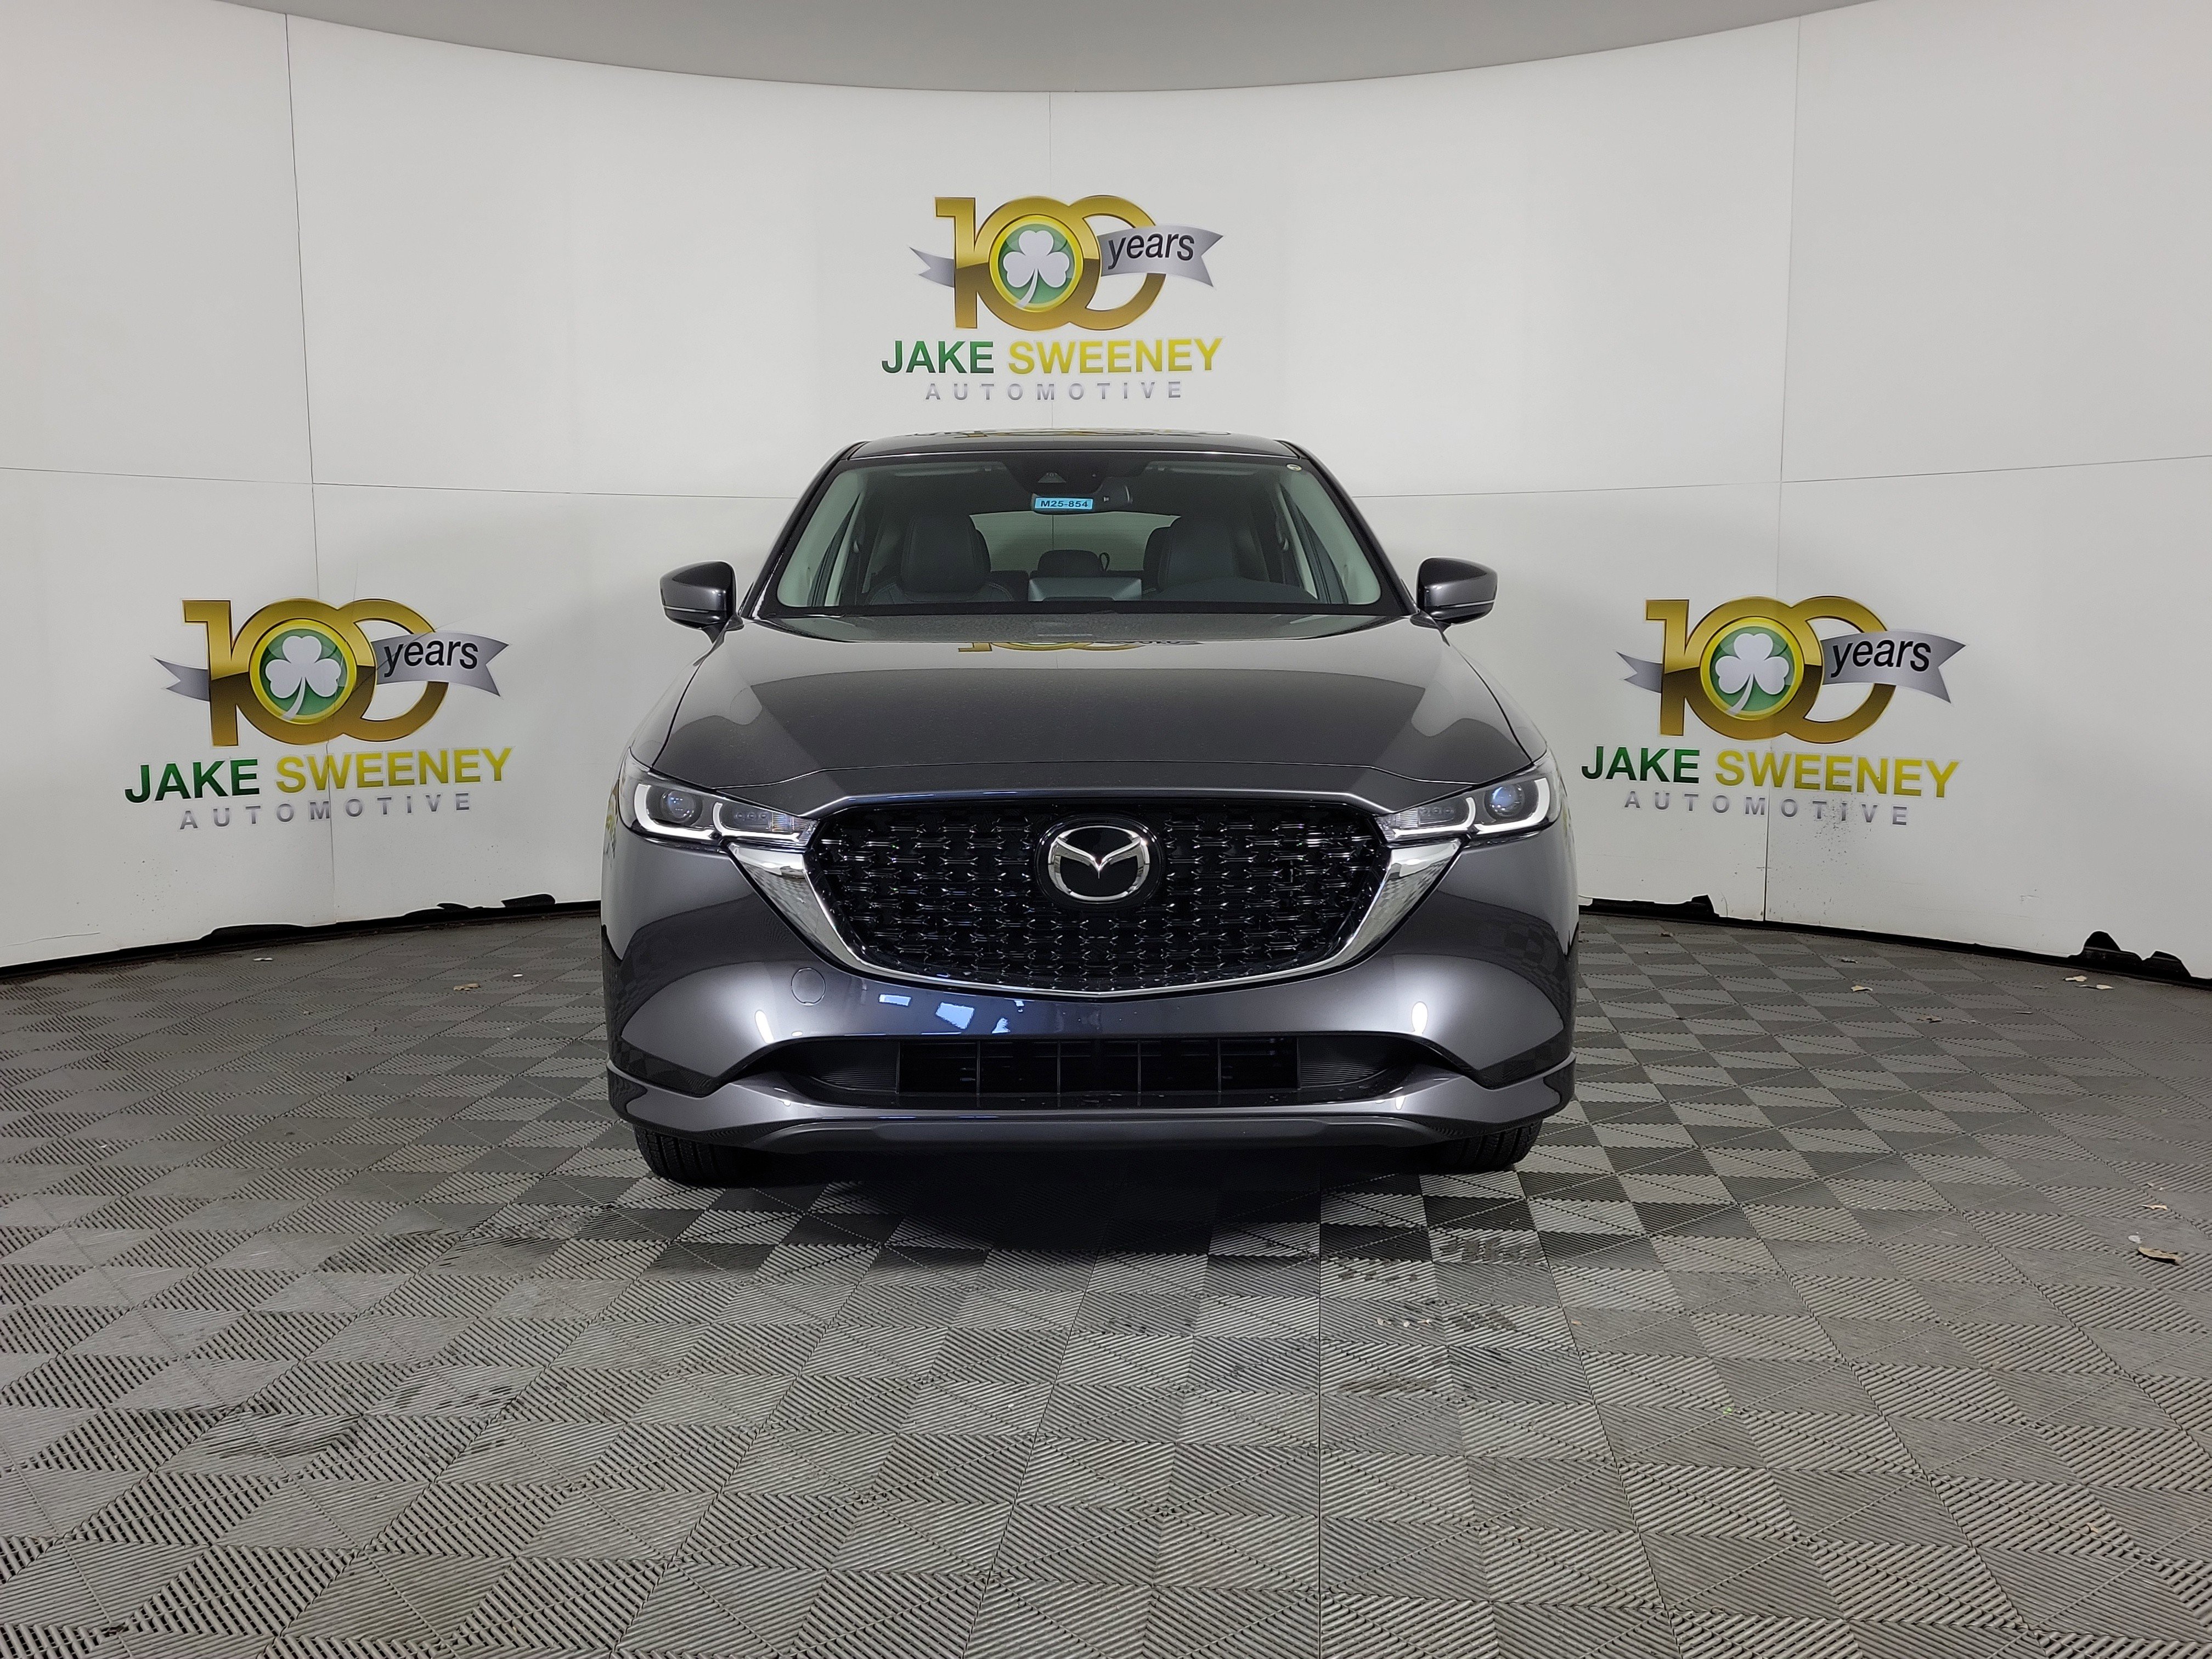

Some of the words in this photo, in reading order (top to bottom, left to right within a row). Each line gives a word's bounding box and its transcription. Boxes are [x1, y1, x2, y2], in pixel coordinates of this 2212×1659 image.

[934, 194, 1166, 331] 100
[1107, 233, 1195, 270] years
[881, 340, 994, 374] JAKE
[1008, 337, 1223, 374] SWEENEY
[925, 381, 1181, 400] AUTOMOTIVE
[182, 597, 449, 746] 100
[383, 640, 479, 677] years
[1646, 596, 1897, 744] 100
[1830, 639, 1932, 678] years
[125, 759, 260, 803] JAKE
[276, 747, 512, 793] SWEENEY
[1581, 746, 1700, 783] JAKE
[1716, 749, 1960, 798] SWEENEY
[179, 793, 470, 830] AUTOMOTIVE
[1624, 791, 1908, 825] AUTOMOTIVE
